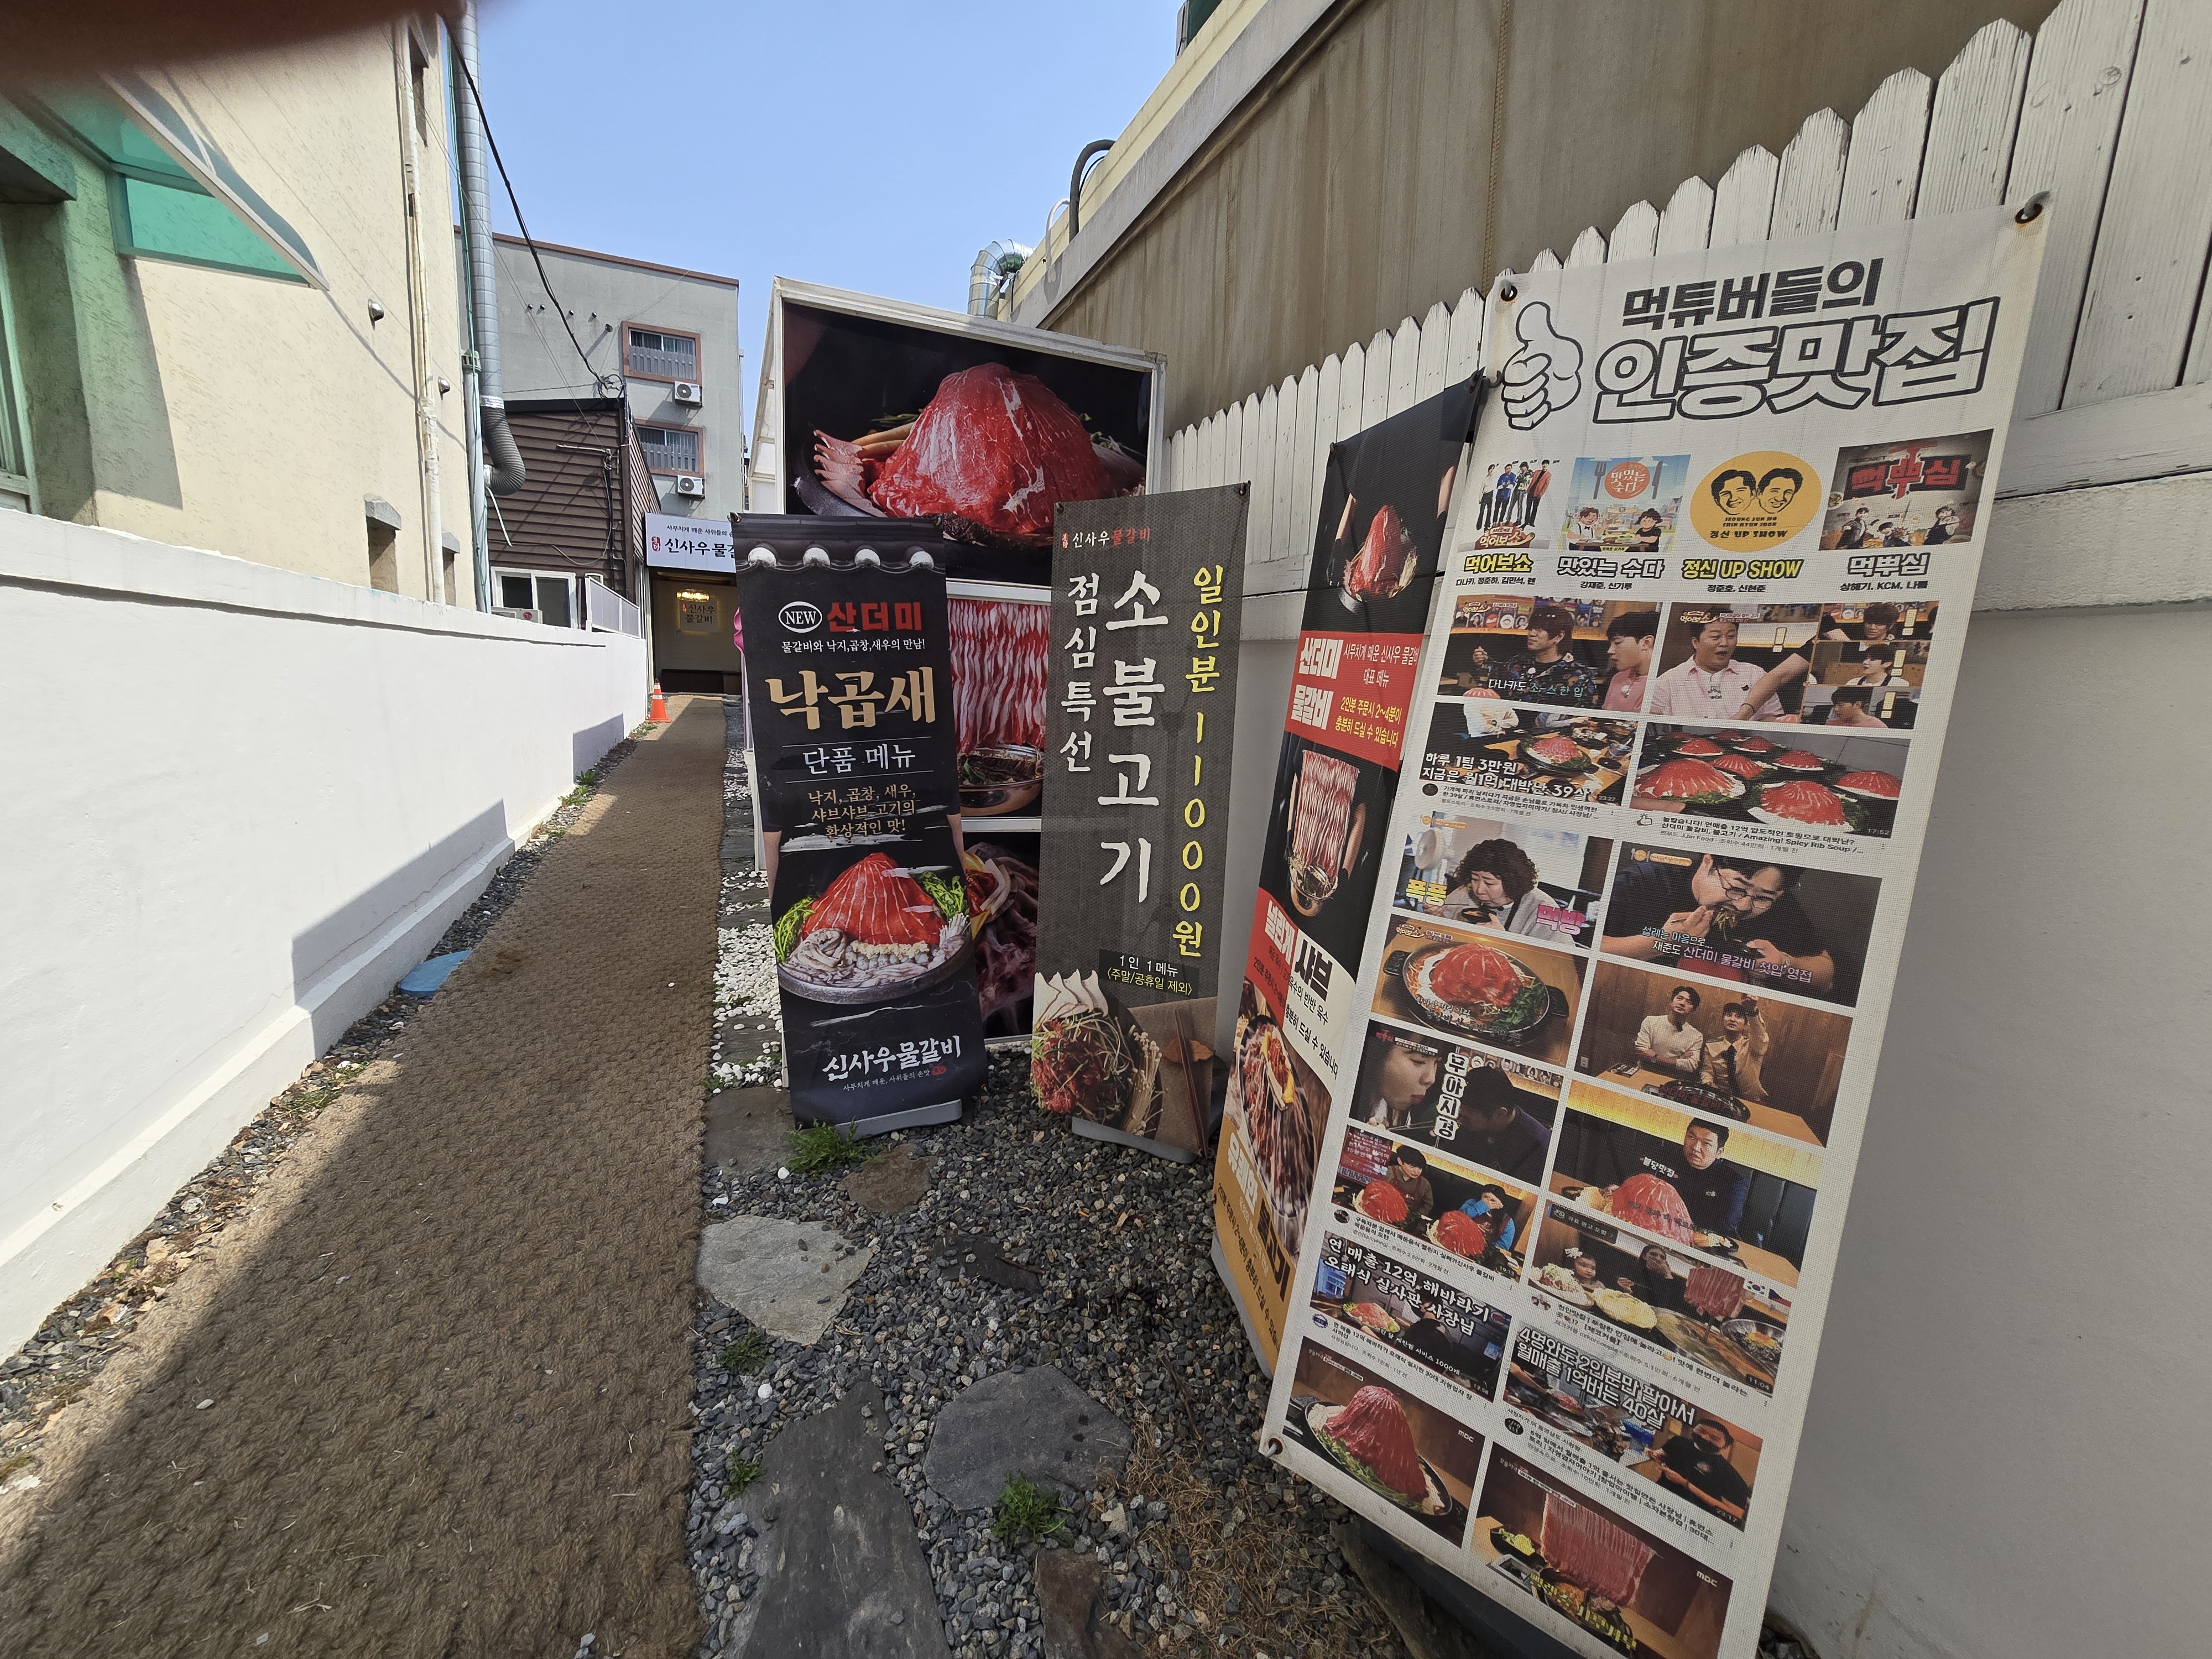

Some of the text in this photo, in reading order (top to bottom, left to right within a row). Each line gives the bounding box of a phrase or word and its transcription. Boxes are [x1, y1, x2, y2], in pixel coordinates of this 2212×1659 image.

[1623, 258, 1884, 331] 먹튜버들의
[1592, 296, 2000, 424] 인증맛집
[1611, 469, 1646, 484] 맛있는
[1614, 481, 1637, 494] 수다
[665, 539, 710, 555] 신사우
[1464, 553, 1534, 574] 먹어보쇼
[1556, 556, 1665, 578] 맛있는 수다
[1681, 559, 1804, 580] 정신 UP SHOW
[1848, 552, 1930, 577] 먹뿌심
[1501, 577, 1525, 585] 김민석,
[1876, 582, 1903, 591] KCM,
[685, 614, 712, 623] 물갈비
[785, 611, 817, 624] NEW
[827, 602, 922, 632] 산더미
[1185, 565, 1224, 693] 일인분
[782, 641, 823, 653] 물갈비와
[904, 639, 925, 650] 만남!
[1298, 638, 1344, 679] 산더미
[1343, 644, 1366, 661] 사무치게
[1368, 645, 1380, 662] 매운
[1381, 645, 1400, 664] 신사우
[1060, 572, 1100, 773] 점심특선
[1363, 668, 1389, 688] 대표 메뉴
[765, 666, 936, 729] 낙곱새
[1488, 679, 1584, 697] 다나카도 한 입
[1291, 684, 1334, 731] 물갈비
[1340, 696, 1356, 713] 2인분
[1358, 699, 1375, 718] 주문시
[1098, 570, 1168, 903] 소불고기
[1334, 716, 1399, 748] 충분히 드실 수 있습니다
[803, 743, 916, 774] 단품 메뉴
[1425, 753, 1517, 775] 하루 1팀 3만원
[808, 784, 916, 806] 낙지, 곱창, 새우,
[1422, 768, 1460, 782] 지금은
[1551, 784, 1593, 801] 39살
[811, 800, 916, 821] 샤브샤브 고기의
[825, 820, 906, 839] 환상적인 맛!
[1786, 838, 1808, 847] Spicy
[1827, 844, 1851, 853] Soup
[1406, 878, 1448, 907] 폭풍
[1536, 904, 1587, 936] 먹방
[1642, 926, 1668, 940] 설레는
[1120, 955, 1139, 970] 1인
[1294, 938, 1333, 1002] 샤브
[1652, 941, 1681, 956] 재준도
[1684, 947, 1718, 963] 산더미
[1721, 954, 1755, 971] 물갈비
[1787, 967, 1812, 983] 영접
[1304, 992, 1316, 1013] 반반
[1317, 1004, 1328, 1025] 육수
[1298, 1022, 1310, 1044] 드실
[1312, 1037, 1318, 1051] 수
[822, 1035, 961, 1081] 신사우물갈비
[843, 1079, 870, 1092] 사무치게
[889, 1071, 915, 1083] 사위들의
[917, 1068, 930, 1079] 손맛
[1328, 1237, 1344, 1253] 연
[1347, 1245, 1379, 1270] 매출
[1382, 1262, 1418, 1285] 12억
[1422, 1279, 1490, 1322] 해바라기
[1324, 1256, 1371, 1285] 오태식
[1376, 1276, 1422, 1308] 실사판
[1427, 1302, 1475, 1337] 사장님
[1516, 1343, 1563, 1379] 월매출
[1566, 1368, 1621, 1406] 1억버는
[1623, 1396, 1666, 1430] 40살
[1519, 1327, 1578, 1366] 4명와도
[1578, 1354, 1640, 1396] 2인분만
[1641, 1381, 1696, 1426] 팔아서
